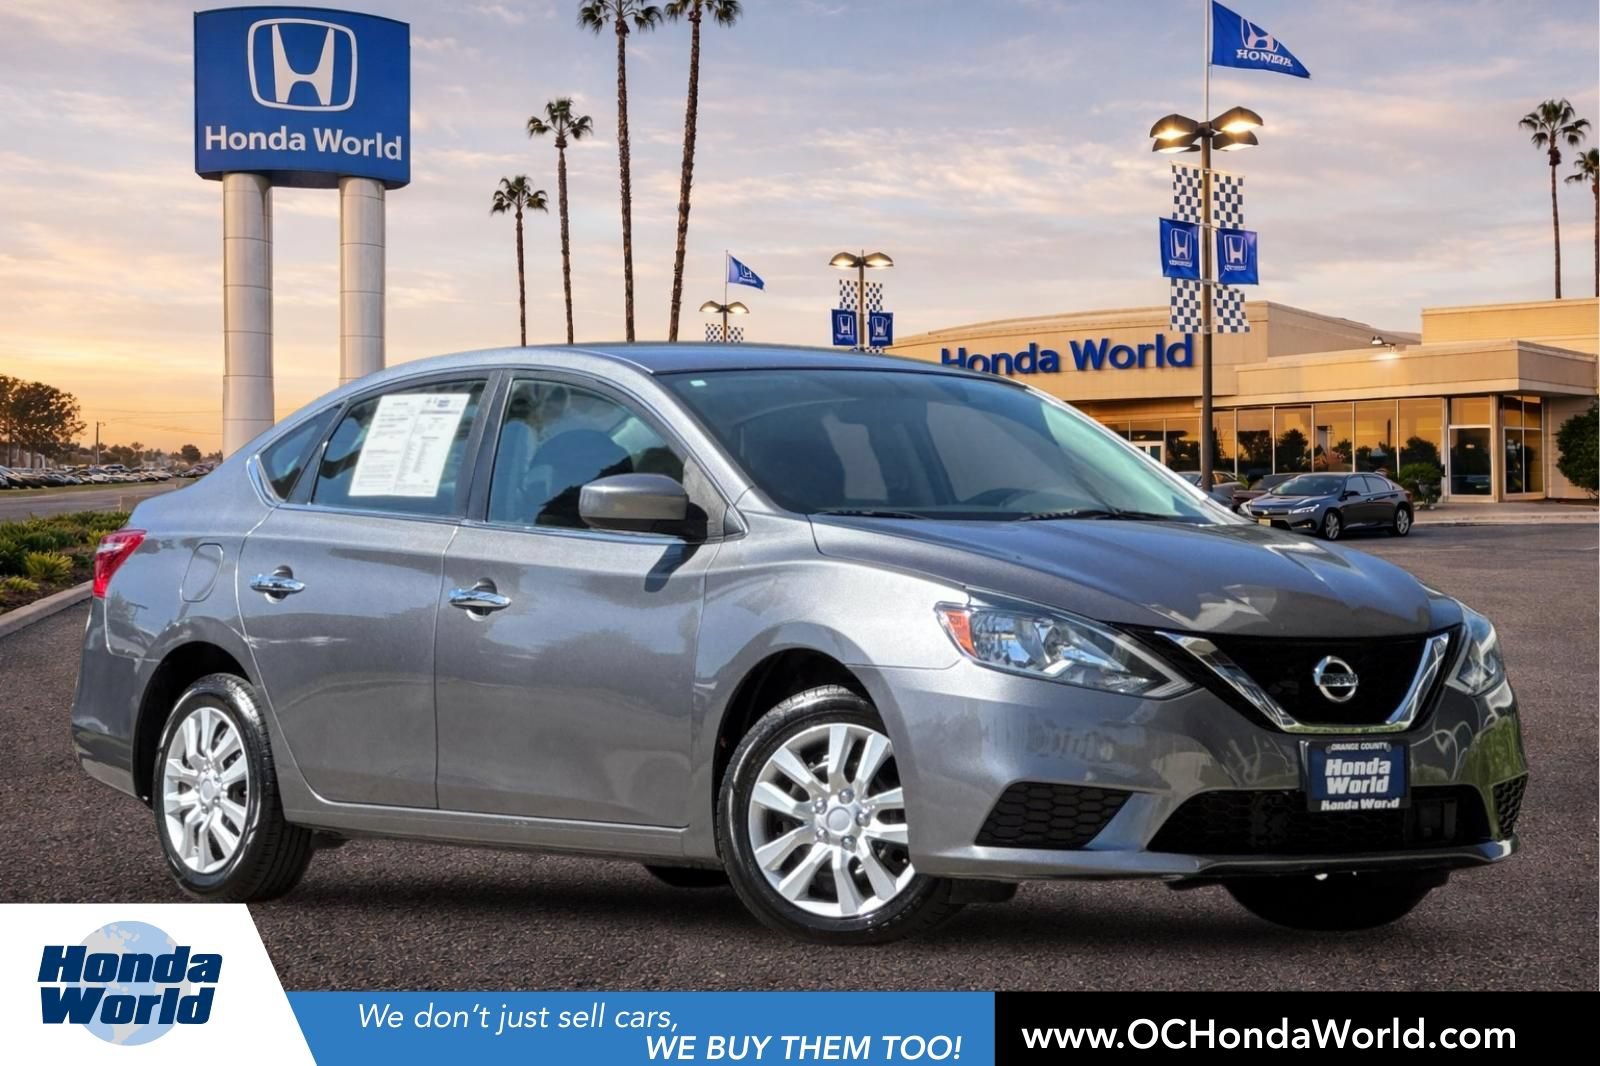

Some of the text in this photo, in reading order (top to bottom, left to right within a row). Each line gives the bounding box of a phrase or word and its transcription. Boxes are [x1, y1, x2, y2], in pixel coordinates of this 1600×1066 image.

[205, 125, 402, 161] Honda World
[941, 333, 1194, 375] Honda World
[1360, 742, 1388, 750] COUNTY
[1325, 757, 1391, 776] Honda
[1326, 775, 1389, 794] World
[1321, 799, 1359, 811] Honda
